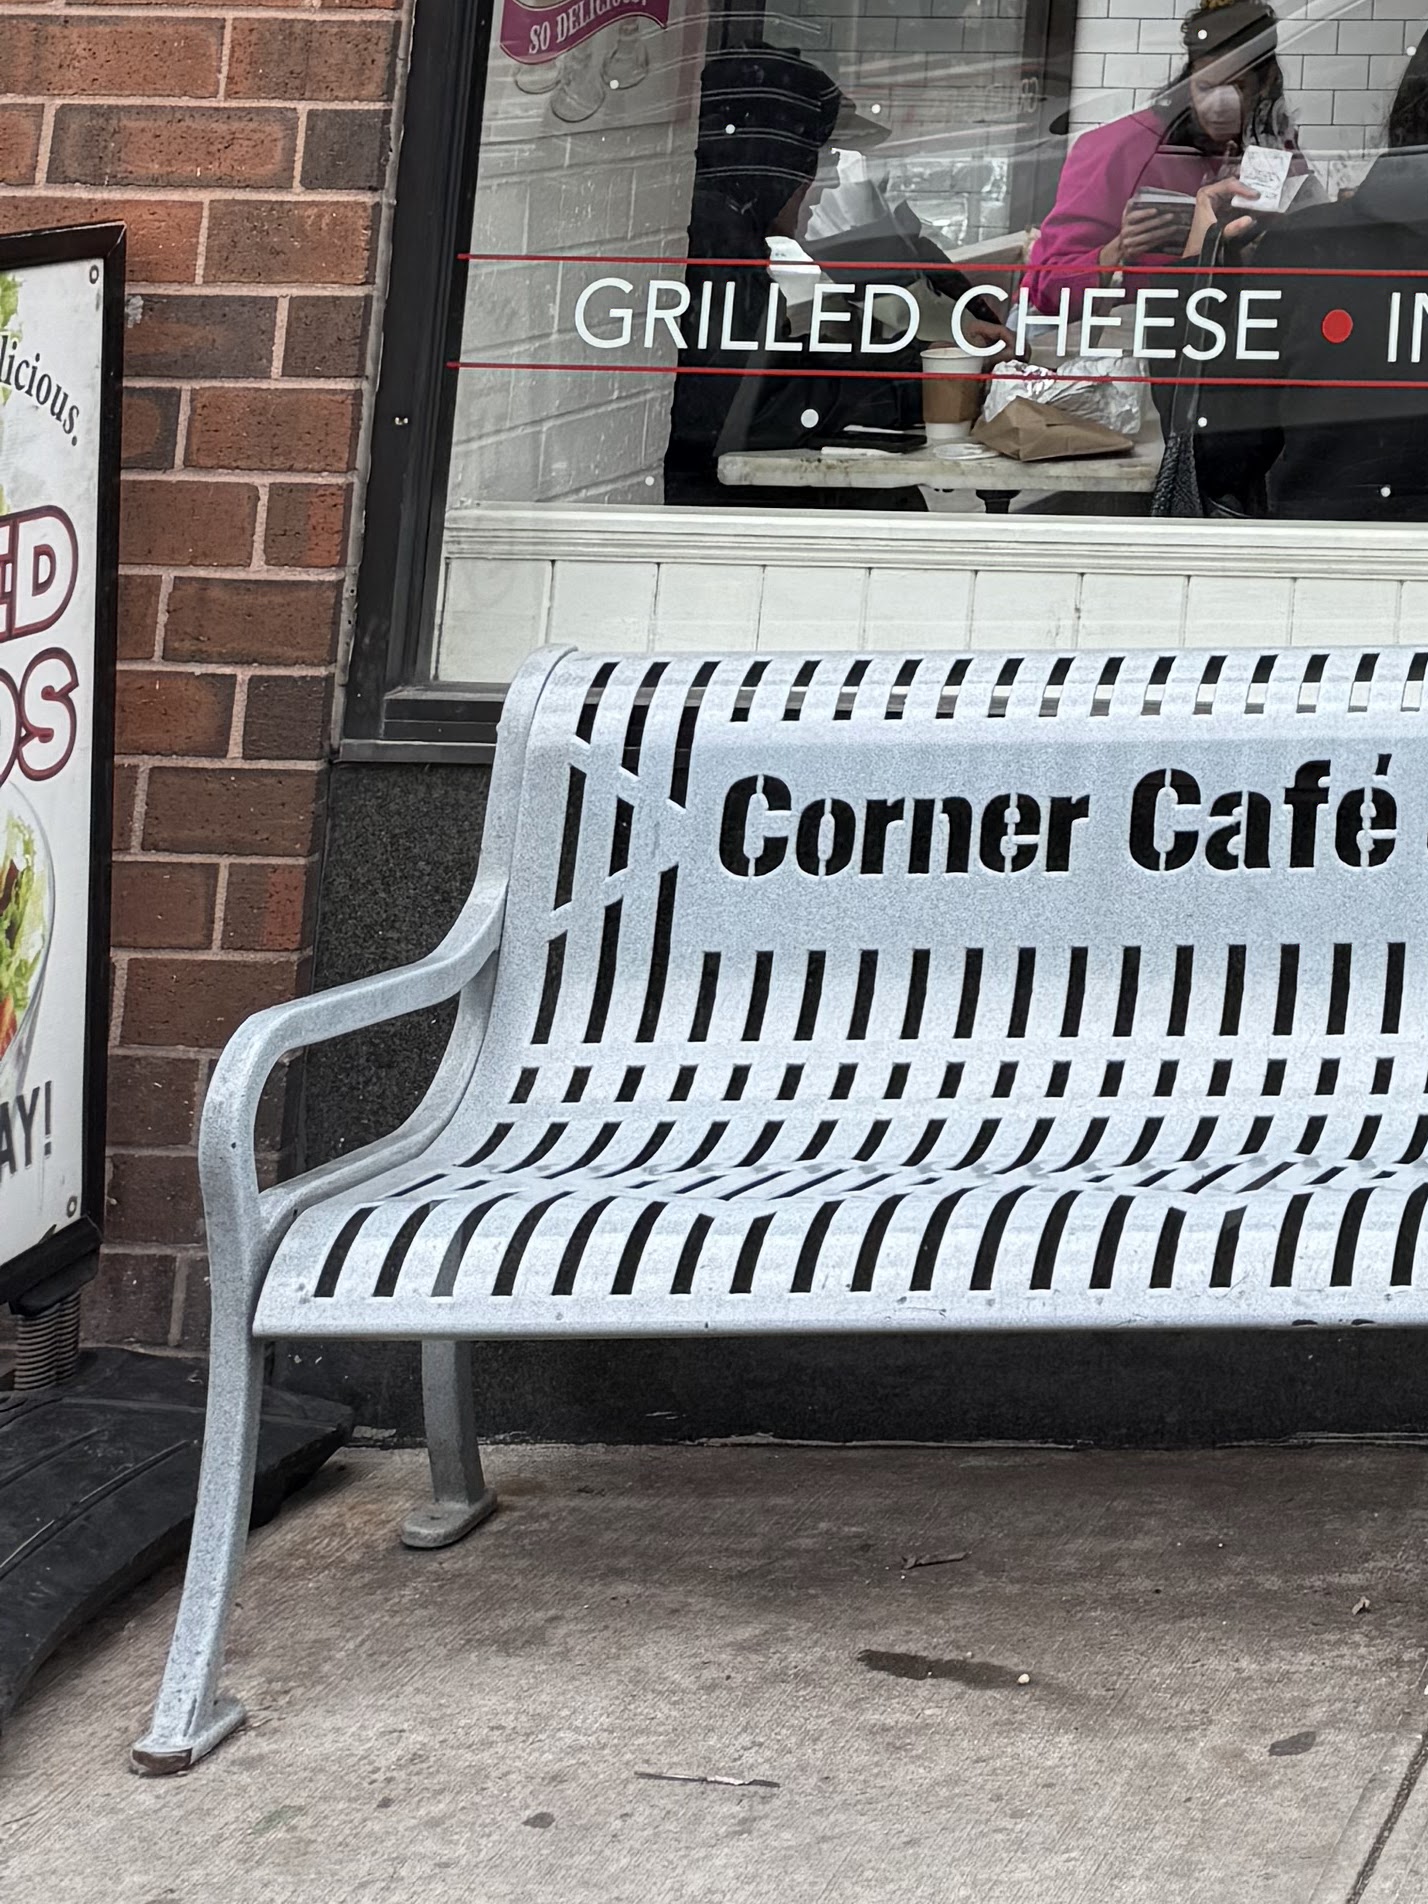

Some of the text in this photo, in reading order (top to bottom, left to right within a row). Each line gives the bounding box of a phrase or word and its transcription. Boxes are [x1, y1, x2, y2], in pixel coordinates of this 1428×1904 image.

[528, 20, 552, 55] SO
[572, 279, 923, 356] GRILLED
[949, 285, 1283, 362] CHEESE
[719, 772, 1091, 877] Corner
[1128, 752, 1398, 873] Café
